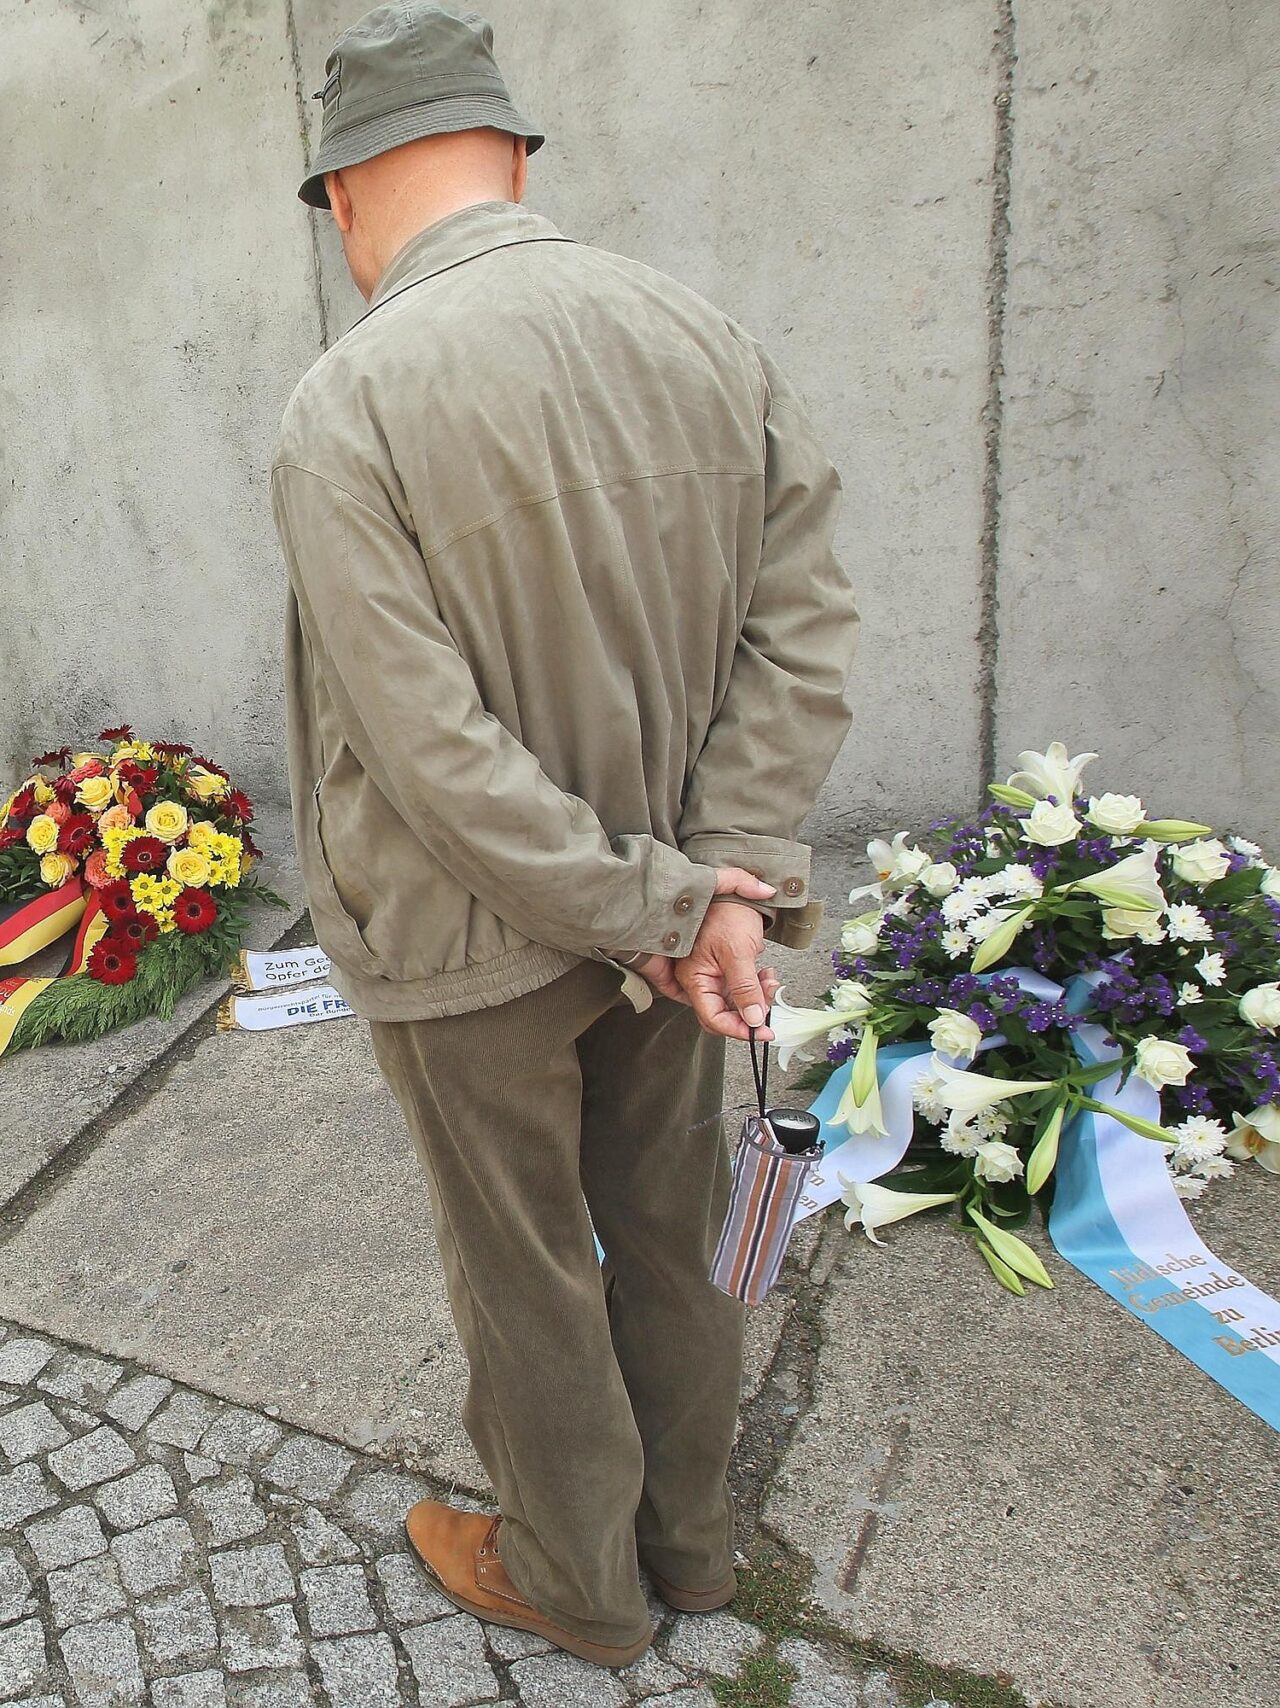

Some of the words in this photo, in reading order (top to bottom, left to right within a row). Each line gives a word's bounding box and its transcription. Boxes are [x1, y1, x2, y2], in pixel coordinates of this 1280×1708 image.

[264, 960, 299, 971] Zum
[265, 970, 307, 981] Opfer
[313, 963, 330, 974] de
[287, 1002, 318, 1016] DIE
[323, 1000, 348, 1010] FR
[1109, 1253, 1208, 1291] Jüdische
[1128, 1272, 1245, 1313] Gemeinde
[1211, 1308, 1246, 1325] zu
